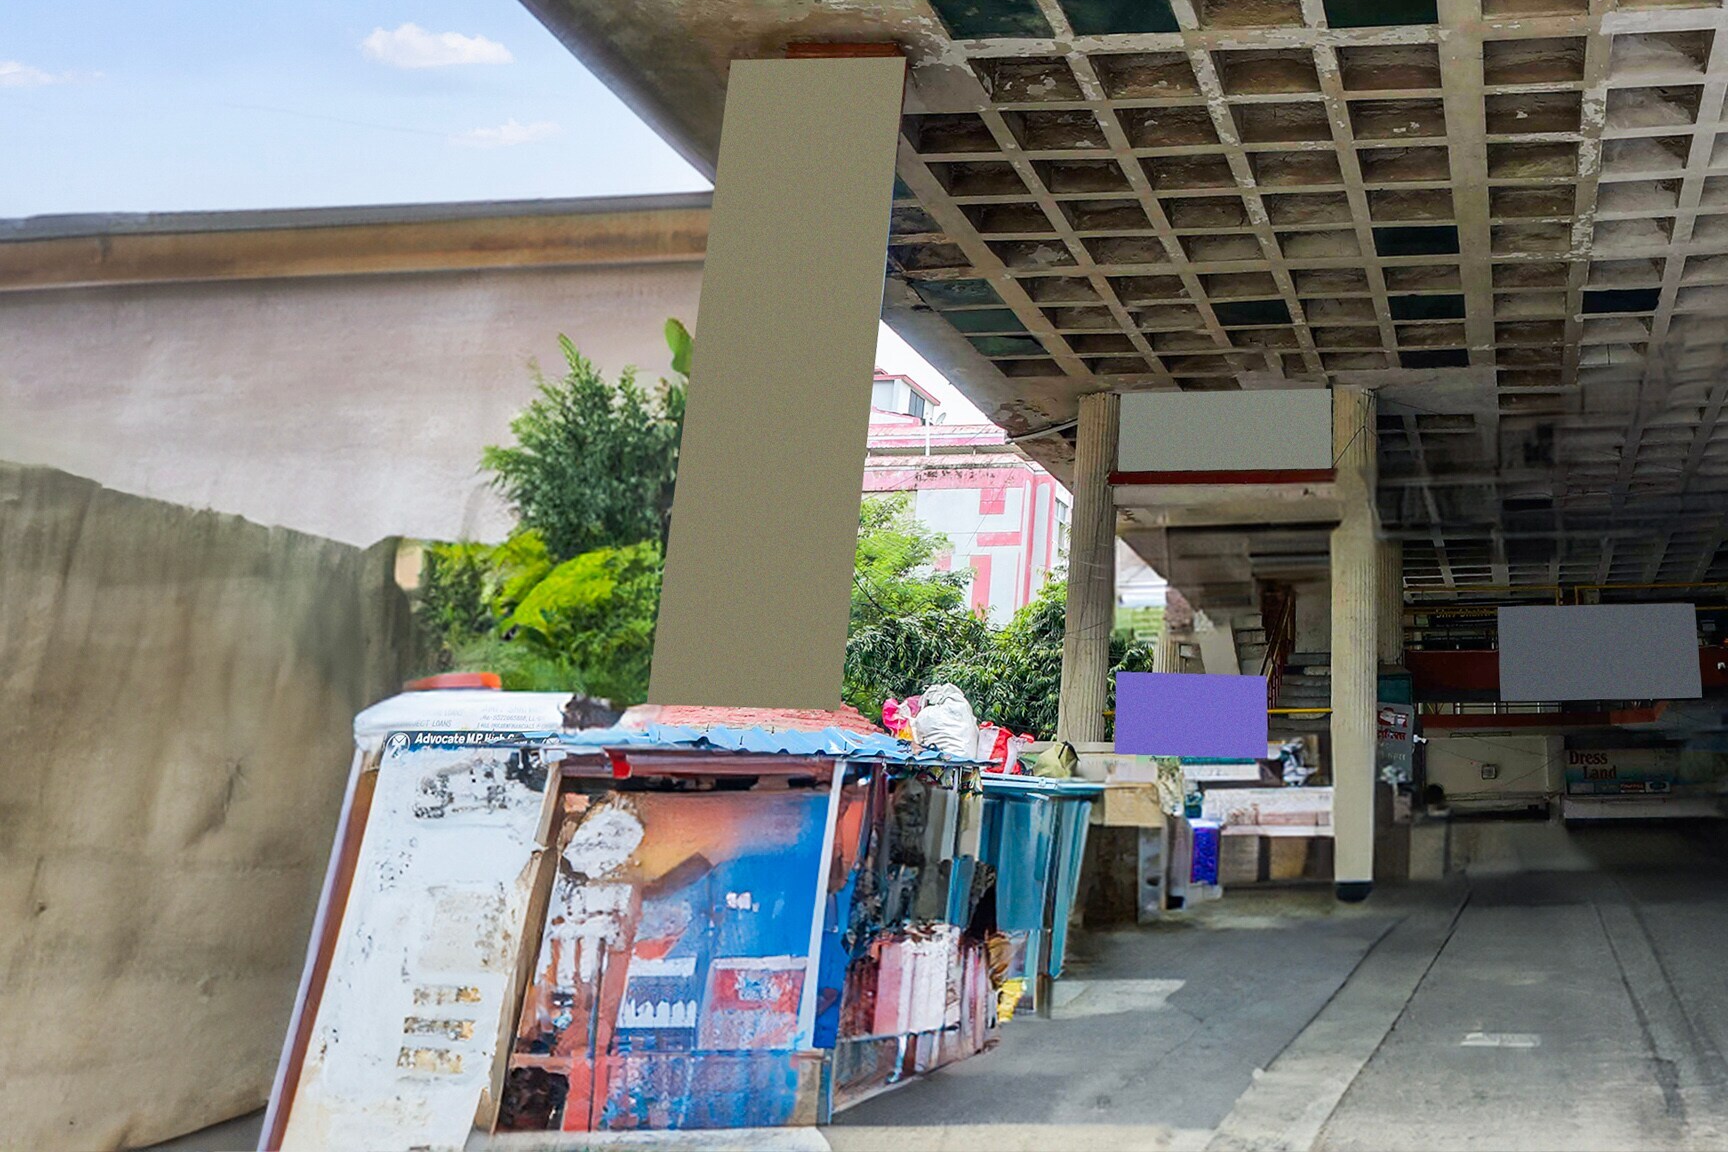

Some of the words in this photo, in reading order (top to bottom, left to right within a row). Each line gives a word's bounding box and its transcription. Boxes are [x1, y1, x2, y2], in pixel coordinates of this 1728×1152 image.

[432, 719, 452, 728] LOANS
[414, 732, 465, 745] Advocate
[1569, 751, 1608, 765] Dress
[1582, 765, 1617, 780] Land
